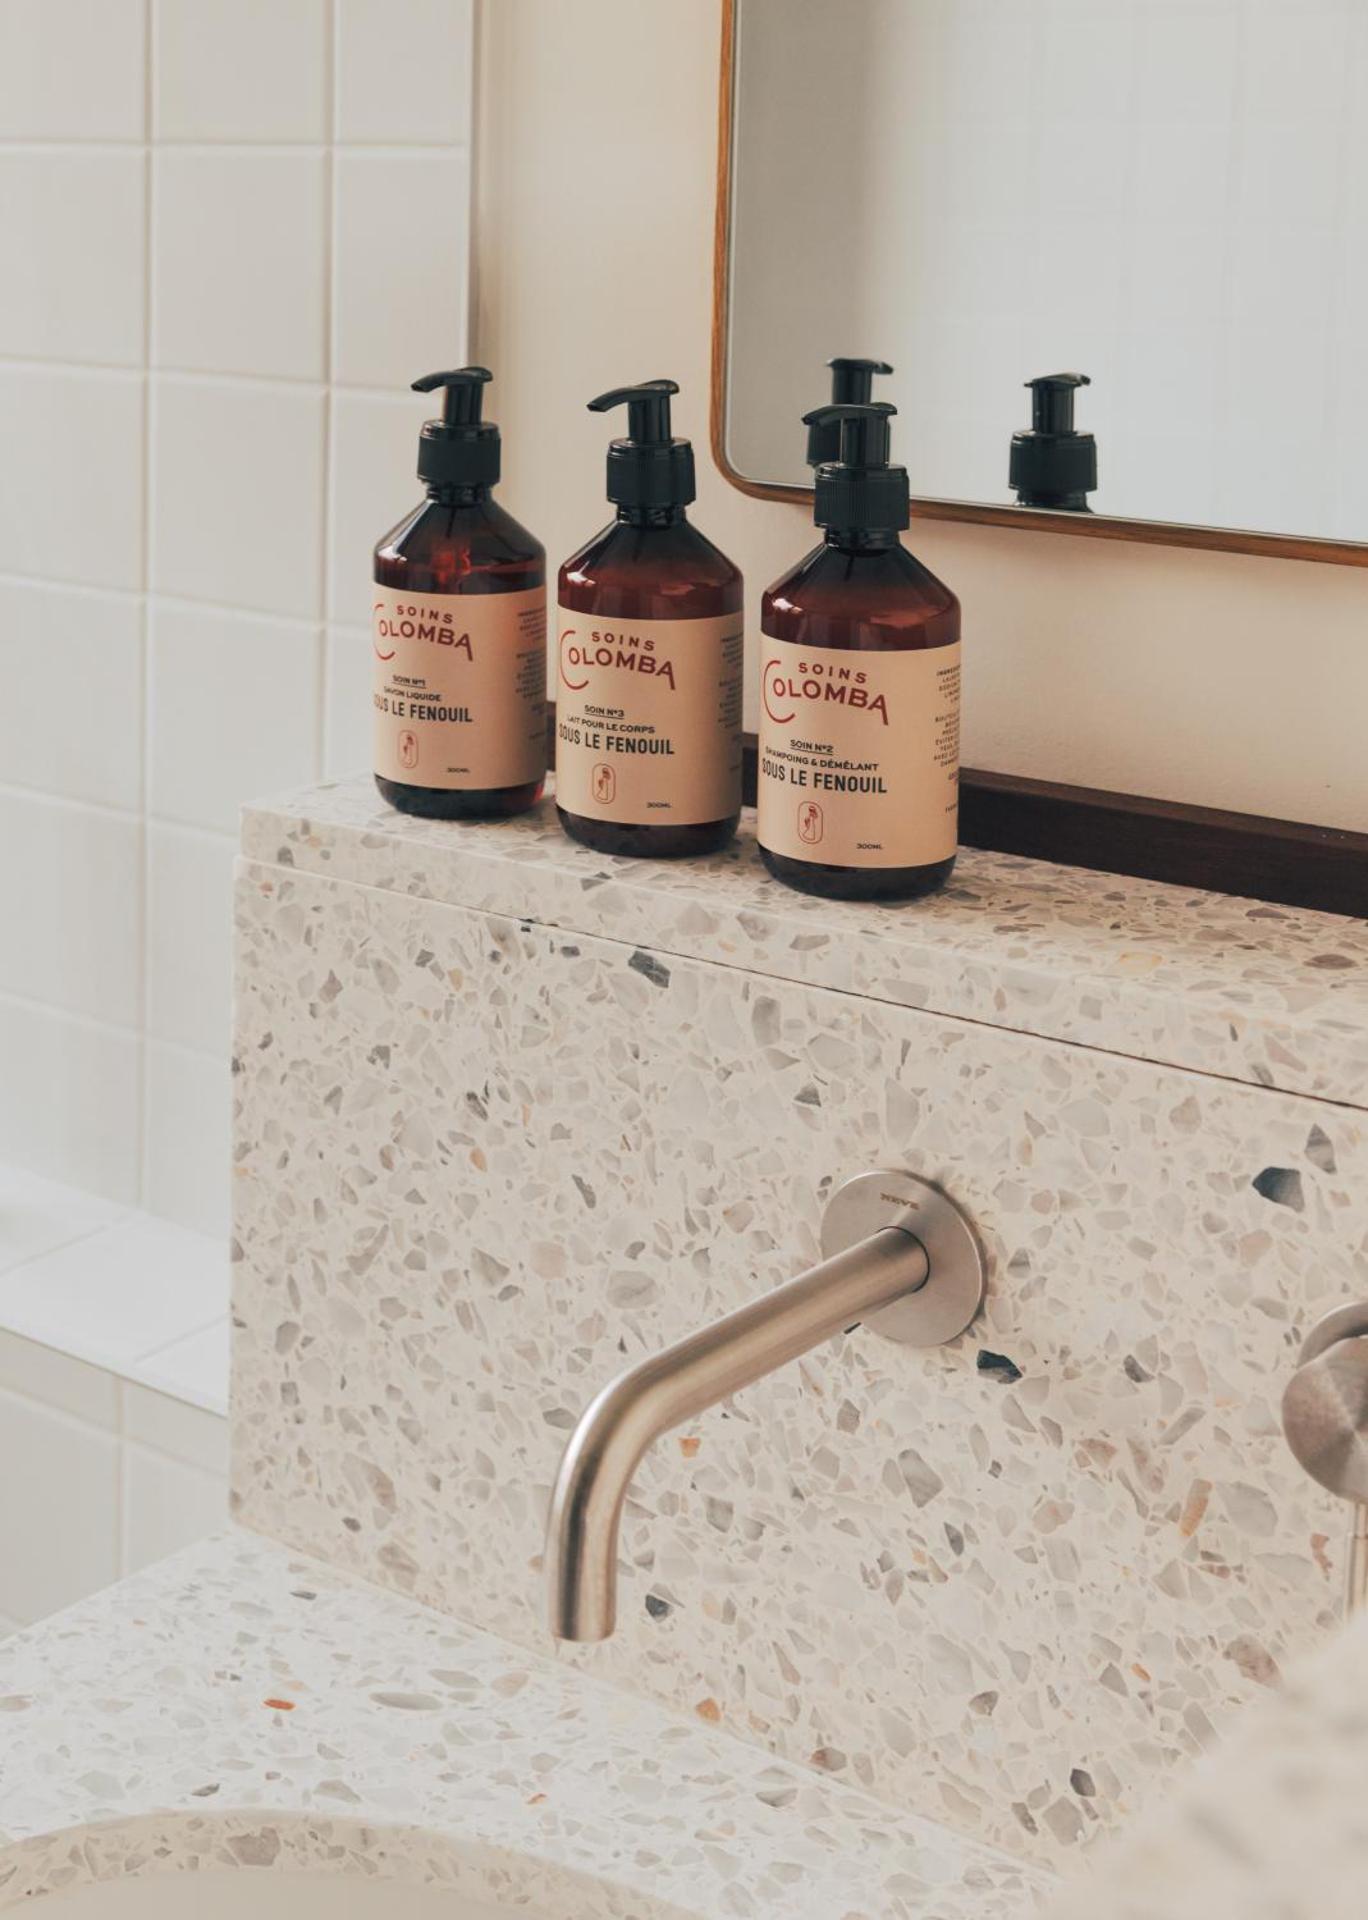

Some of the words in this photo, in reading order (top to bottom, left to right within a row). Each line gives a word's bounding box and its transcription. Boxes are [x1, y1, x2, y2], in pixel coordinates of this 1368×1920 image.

[397, 605, 453, 624] SOINS
[592, 631, 655, 651] SOINS
[560, 630, 676, 691] COLOMBA
[392, 675, 410, 684] SOIN
[798, 662, 867, 683] SOINS
[406, 691, 442, 701] LIQUIDE
[763, 660, 889, 726] COLOMBA
[392, 700, 405, 717] LE
[410, 703, 473, 722] FENOUIL
[584, 705, 604, 714] SOIN
[567, 714, 580, 723] LAIT
[581, 719, 604, 729] POUR
[606, 723, 618, 732] LE
[619, 724, 656, 734] CORPS
[559, 723, 580, 745] SOUS
[585, 732, 600, 749] LE
[606, 735, 675, 755] FENOUIL
[790, 739, 812, 750] SOIN
[765, 746, 809, 765] SHAMPOING
[810, 758, 818, 767] &
[762, 757, 785, 781] SOUS
[790, 767, 807, 786] LE
[813, 772, 888, 794] FENOUIL
